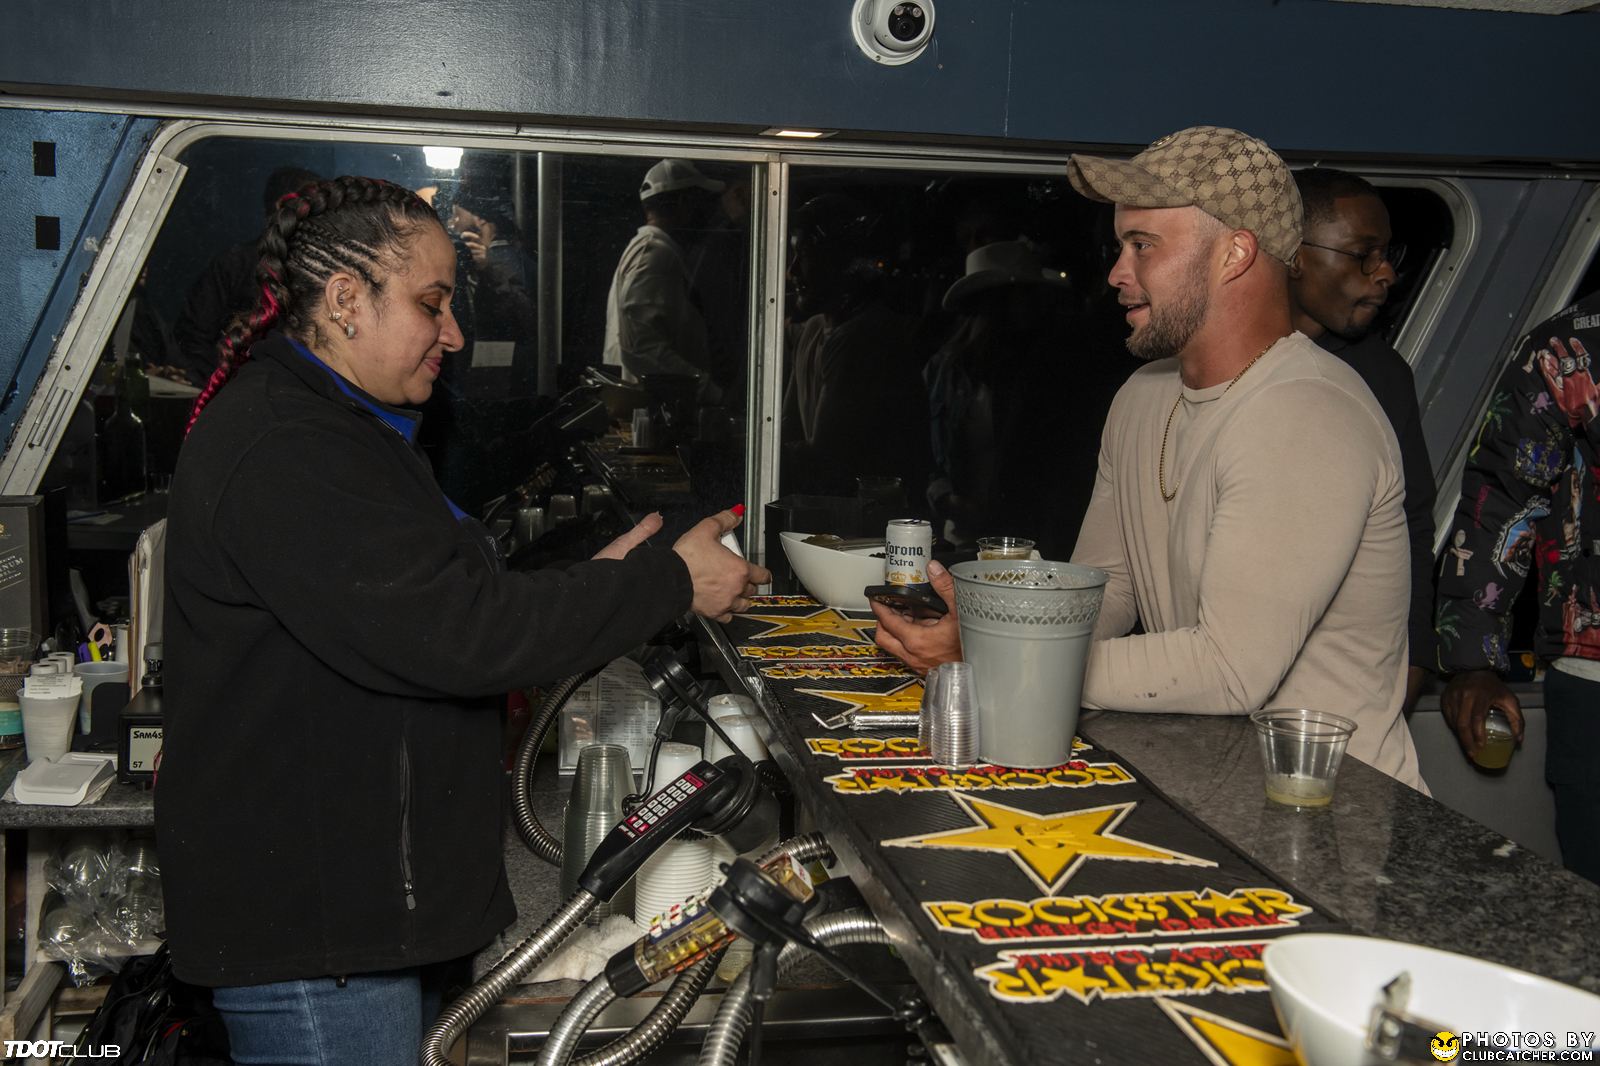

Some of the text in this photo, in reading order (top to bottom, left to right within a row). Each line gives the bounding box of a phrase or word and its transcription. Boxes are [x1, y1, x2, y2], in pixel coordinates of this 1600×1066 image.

[885, 541, 924, 556] Corona
[889, 555, 914, 567] Extra
[132, 761, 143, 769] 57
[1159, 913, 1289, 932] DRINK
